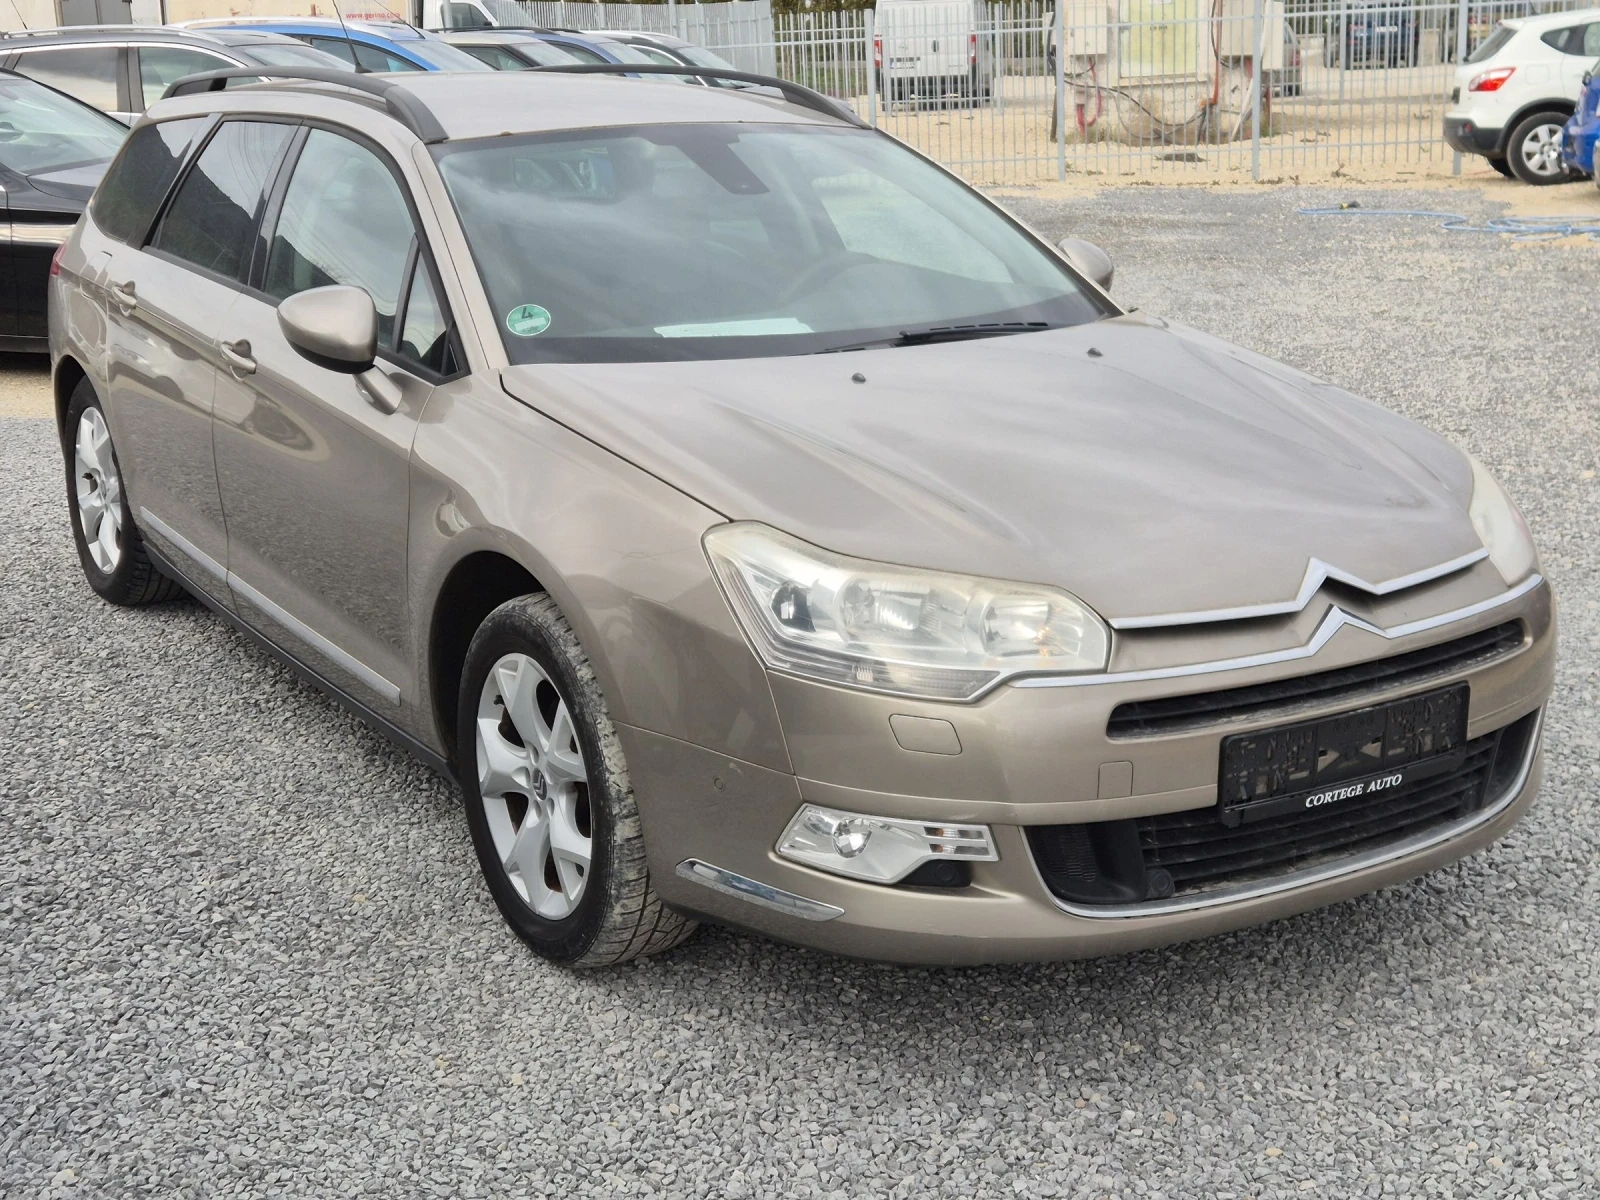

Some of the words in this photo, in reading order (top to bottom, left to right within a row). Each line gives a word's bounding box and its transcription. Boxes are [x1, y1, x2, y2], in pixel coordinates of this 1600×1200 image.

[521, 306, 534, 320] 4
[1305, 783, 1364, 808] CORTEGE
[1366, 773, 1402, 793] AUTO
